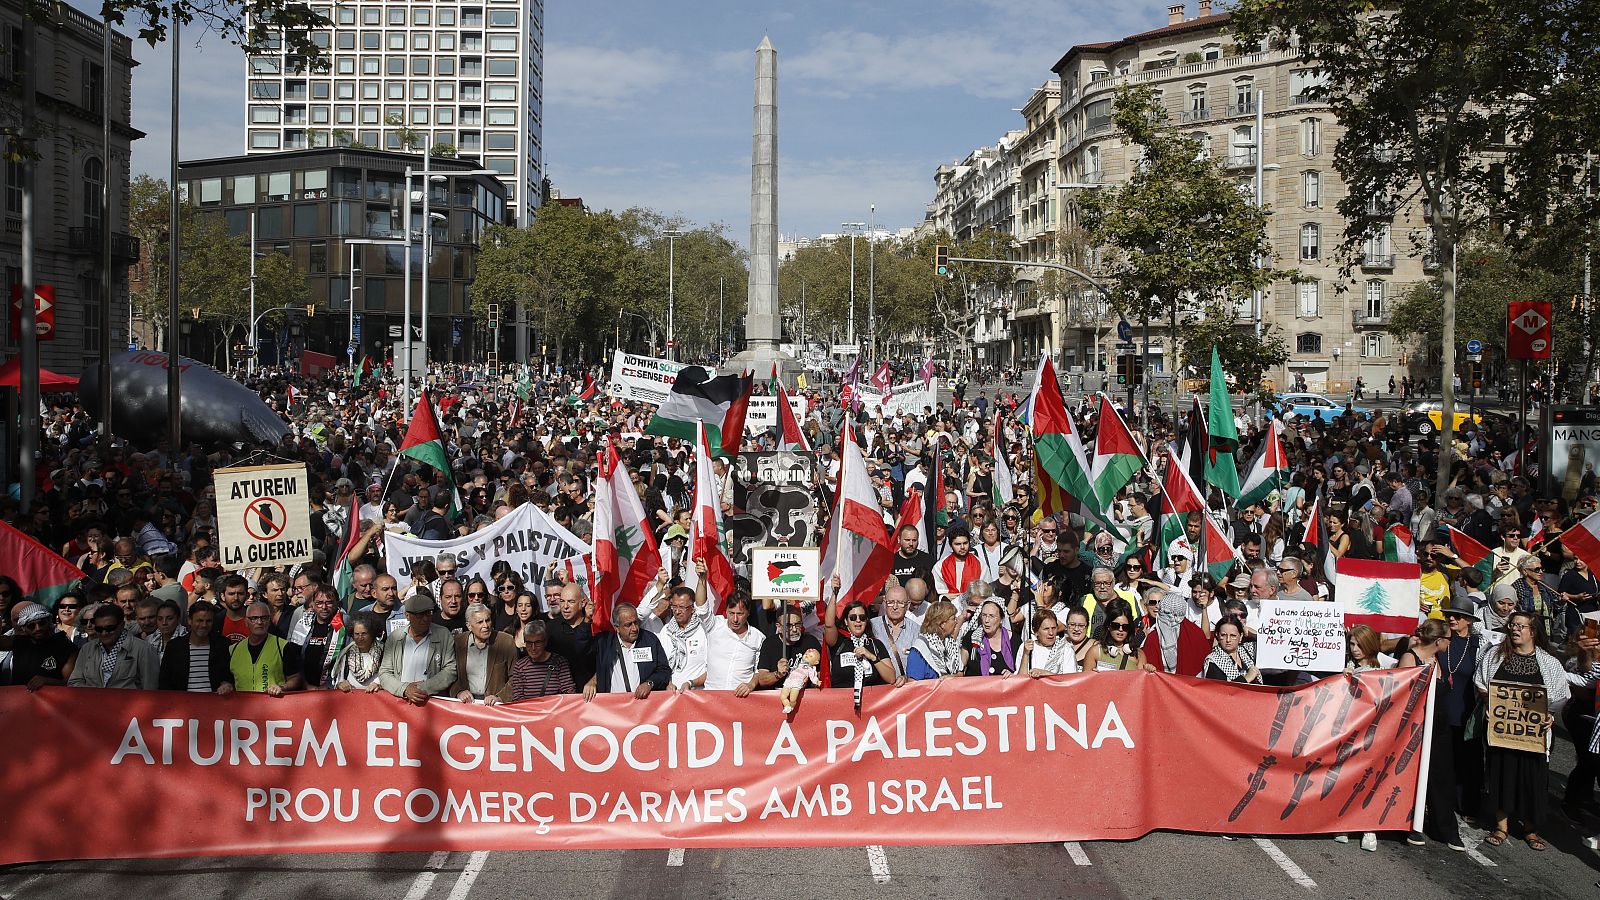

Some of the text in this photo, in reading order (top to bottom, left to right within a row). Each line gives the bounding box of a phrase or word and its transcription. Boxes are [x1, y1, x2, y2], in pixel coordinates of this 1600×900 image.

[1523, 315, 1538, 328] M
[624, 356, 637, 366] NO
[231, 477, 297, 500] ATUREM
[225, 539, 309, 564] LA GUERRA!
[473, 543, 486, 561] Y
[1300, 606, 1323, 618] después
[1324, 607, 1332, 618] de
[1269, 618, 1291, 628] guerra
[1496, 685, 1545, 703] STOP
[1512, 700, 1529, 709] THE
[1493, 704, 1542, 725] GENO
[110, 700, 1136, 774] ATUREM EL GENOCIDI A PALESTINA
[245, 774, 1004, 835] PROU COMERÇ D'ARMES AMB ISRAEL
